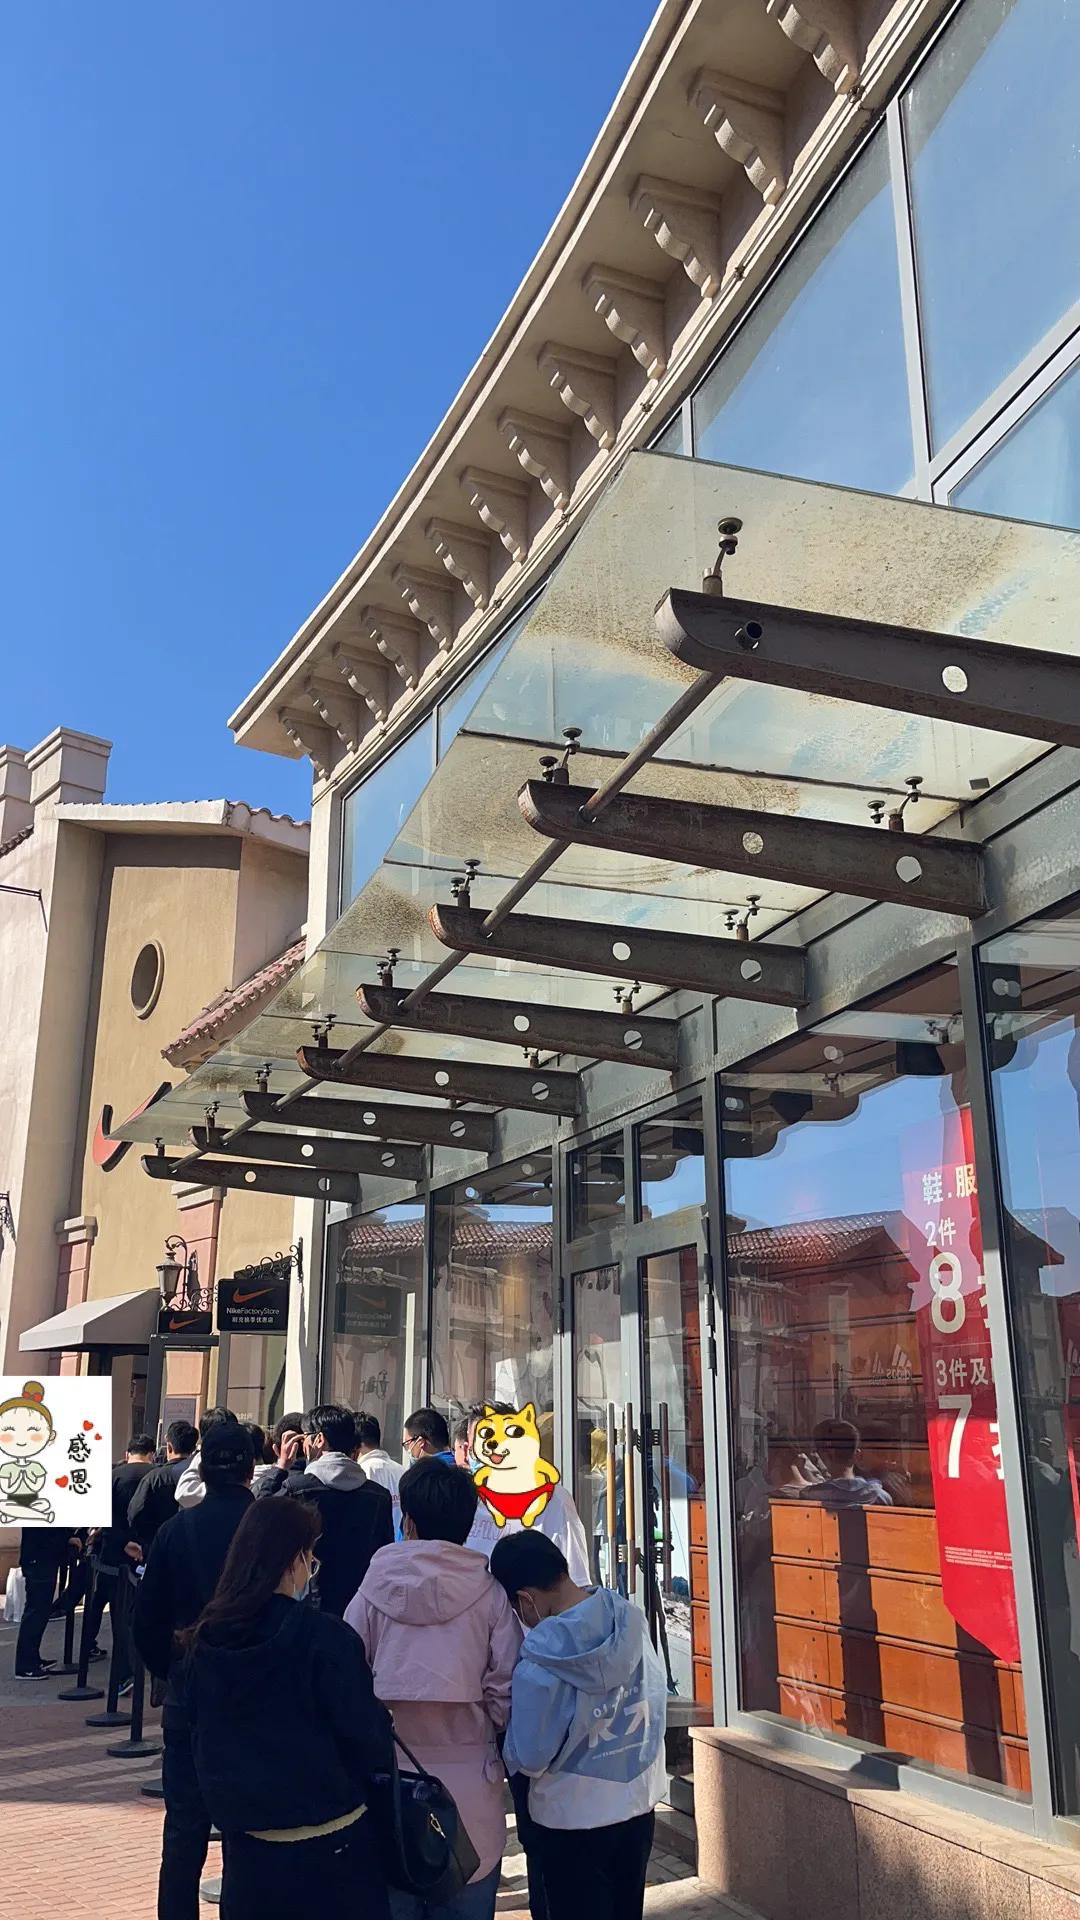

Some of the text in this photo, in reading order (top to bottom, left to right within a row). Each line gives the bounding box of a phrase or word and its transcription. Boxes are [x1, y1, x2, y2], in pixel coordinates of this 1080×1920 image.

[925, 1217, 957, 1247] 2件
[929, 1252, 992, 1334] 8
[935, 1357, 995, 1388] 3件及
